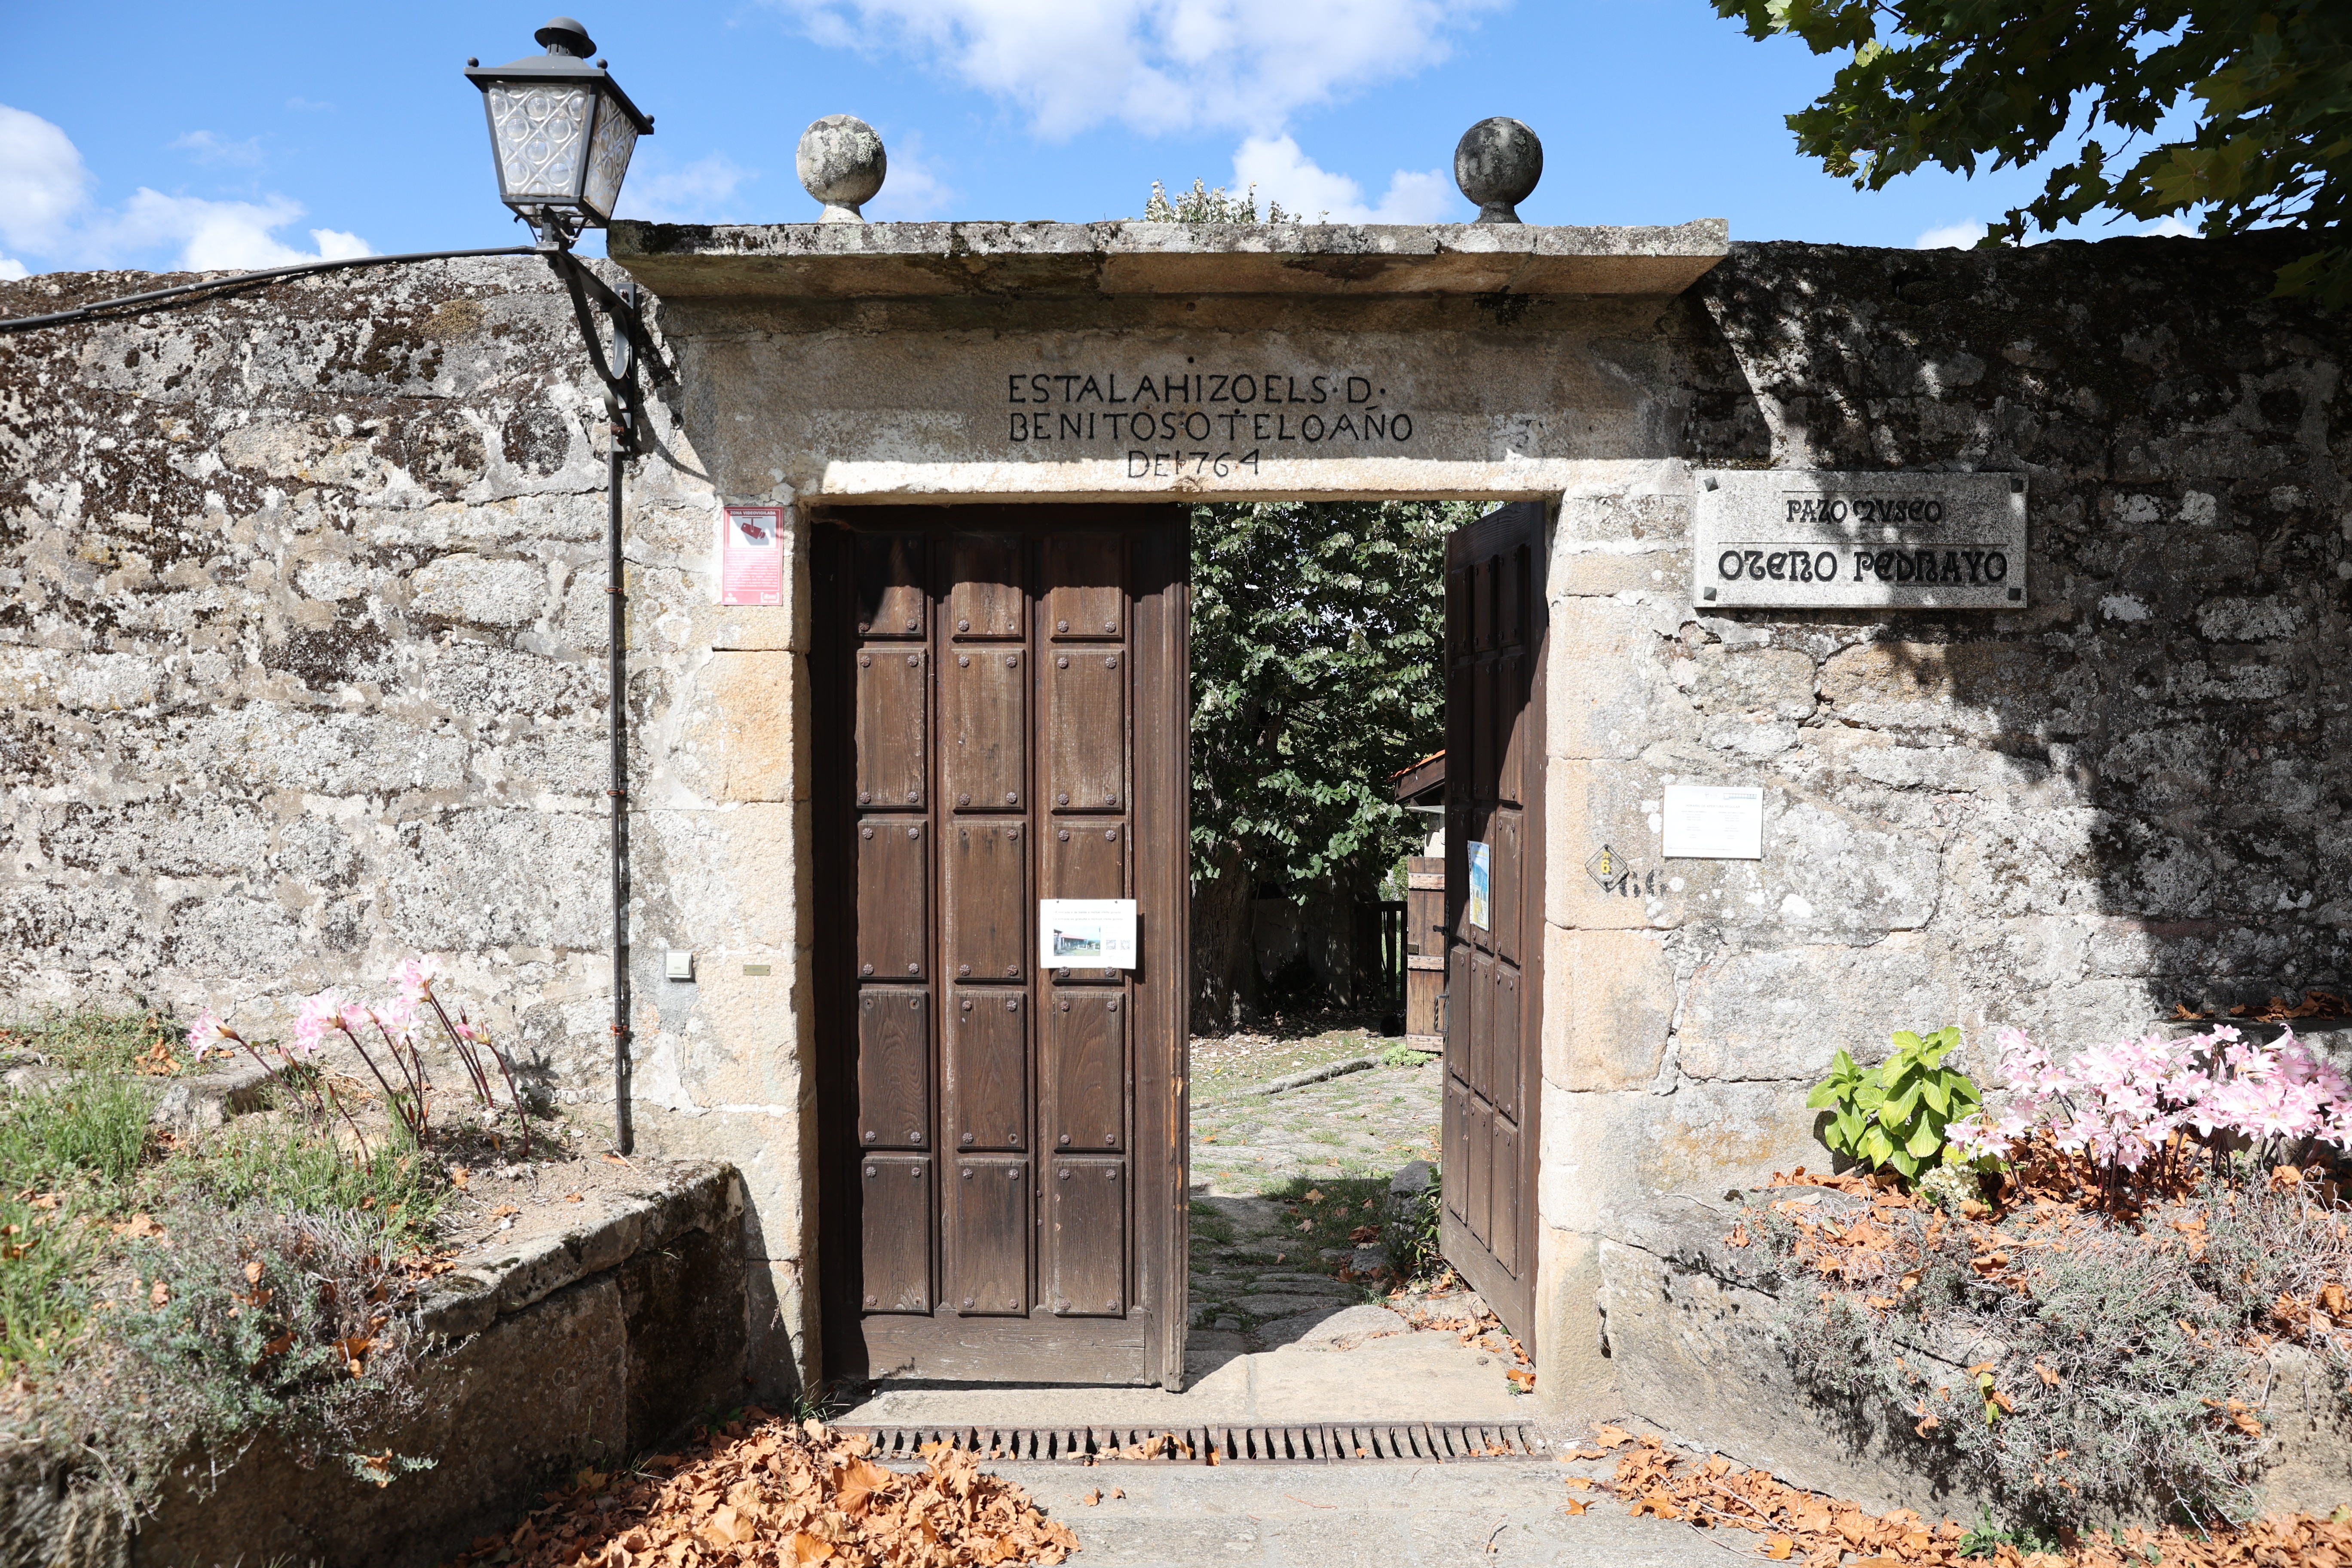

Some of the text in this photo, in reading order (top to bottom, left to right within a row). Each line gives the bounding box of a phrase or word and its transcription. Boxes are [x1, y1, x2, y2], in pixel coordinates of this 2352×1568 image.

[1786, 499, 1848, 524] PAZO
[1718, 549, 2008, 583] OTERO PEDRAYO
[1601, 859, 1611, 873] 6
